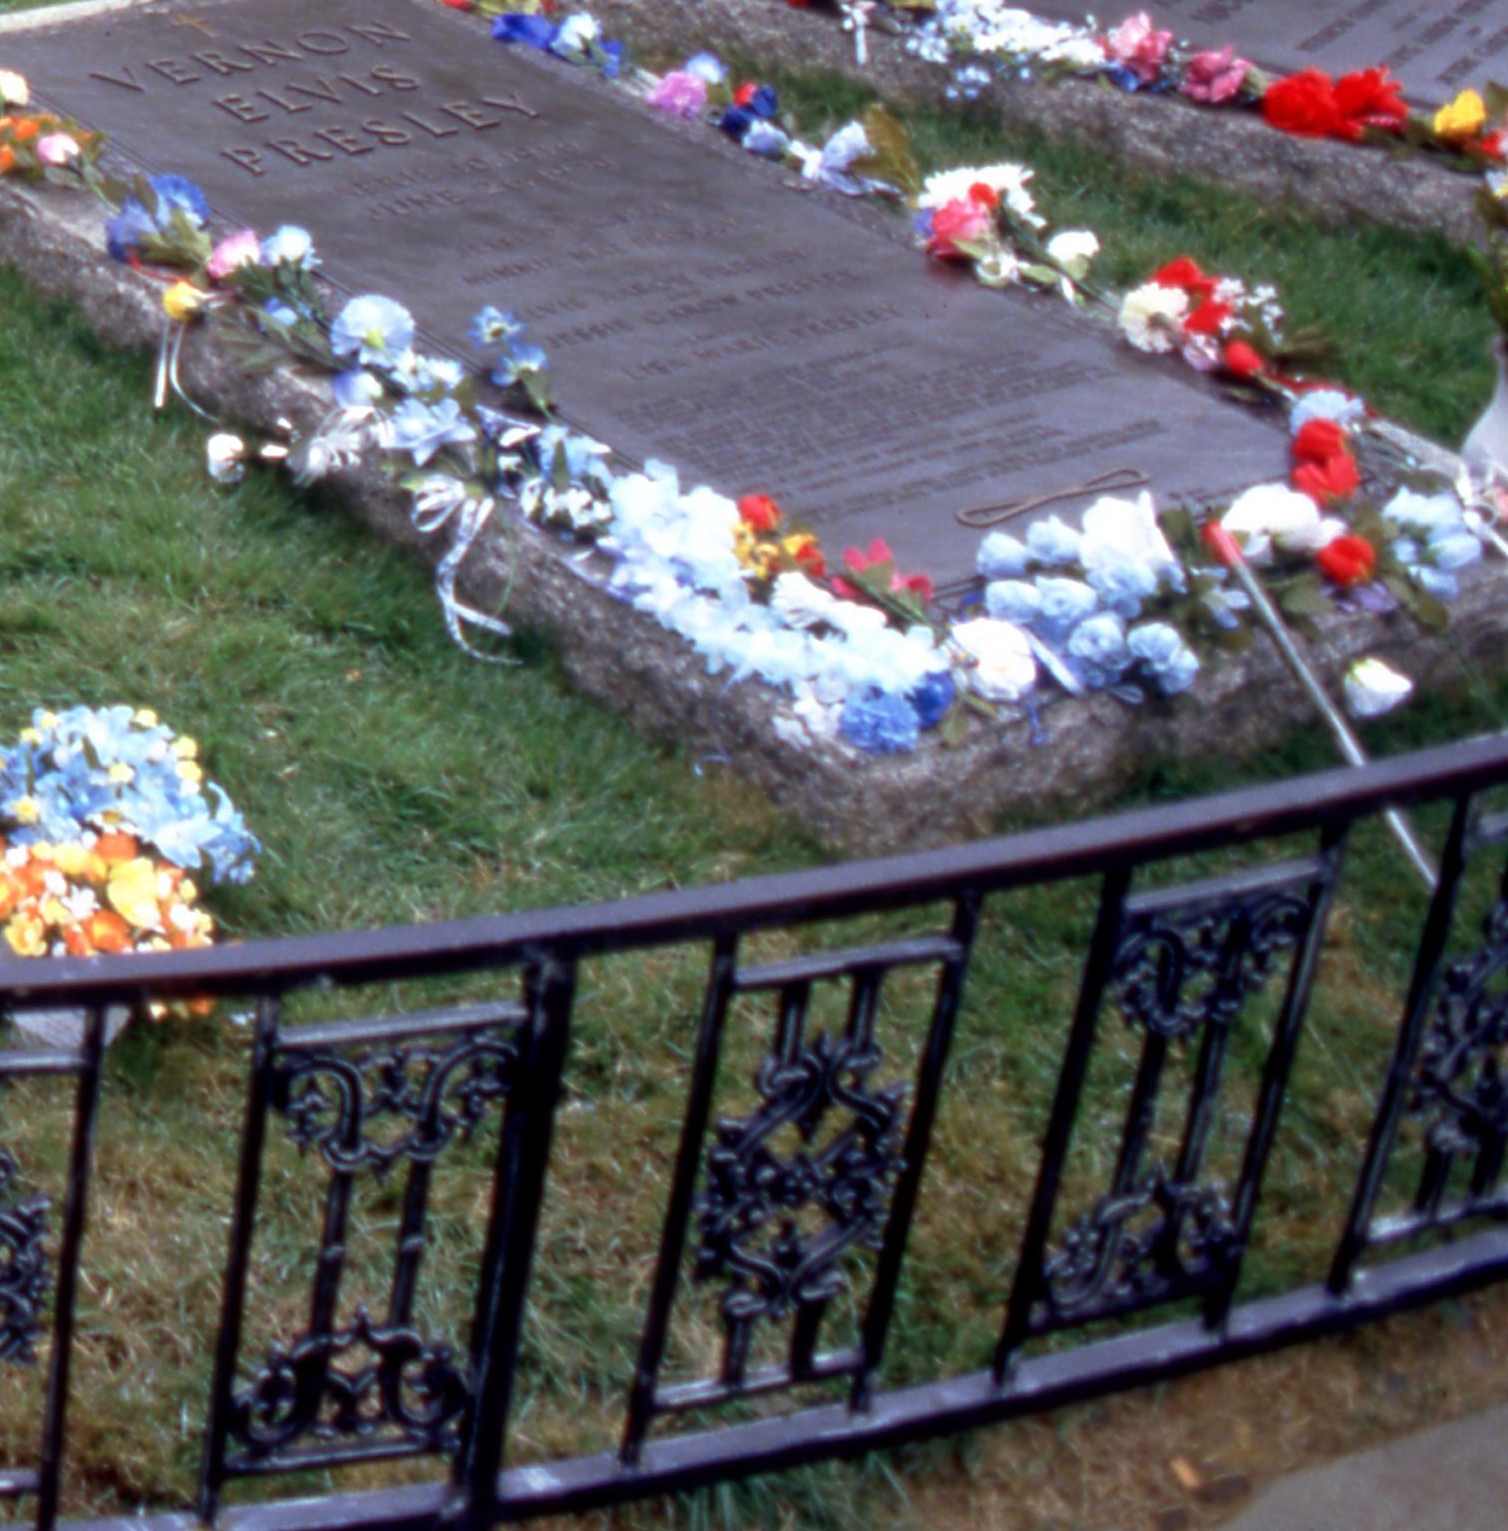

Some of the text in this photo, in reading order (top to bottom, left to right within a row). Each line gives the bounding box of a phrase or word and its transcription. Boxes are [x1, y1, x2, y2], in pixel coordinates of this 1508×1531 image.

[90, 21, 411, 93] VERNON
[213, 65, 422, 124] ELVIS
[220, 94, 540, 176] PRESLEY
